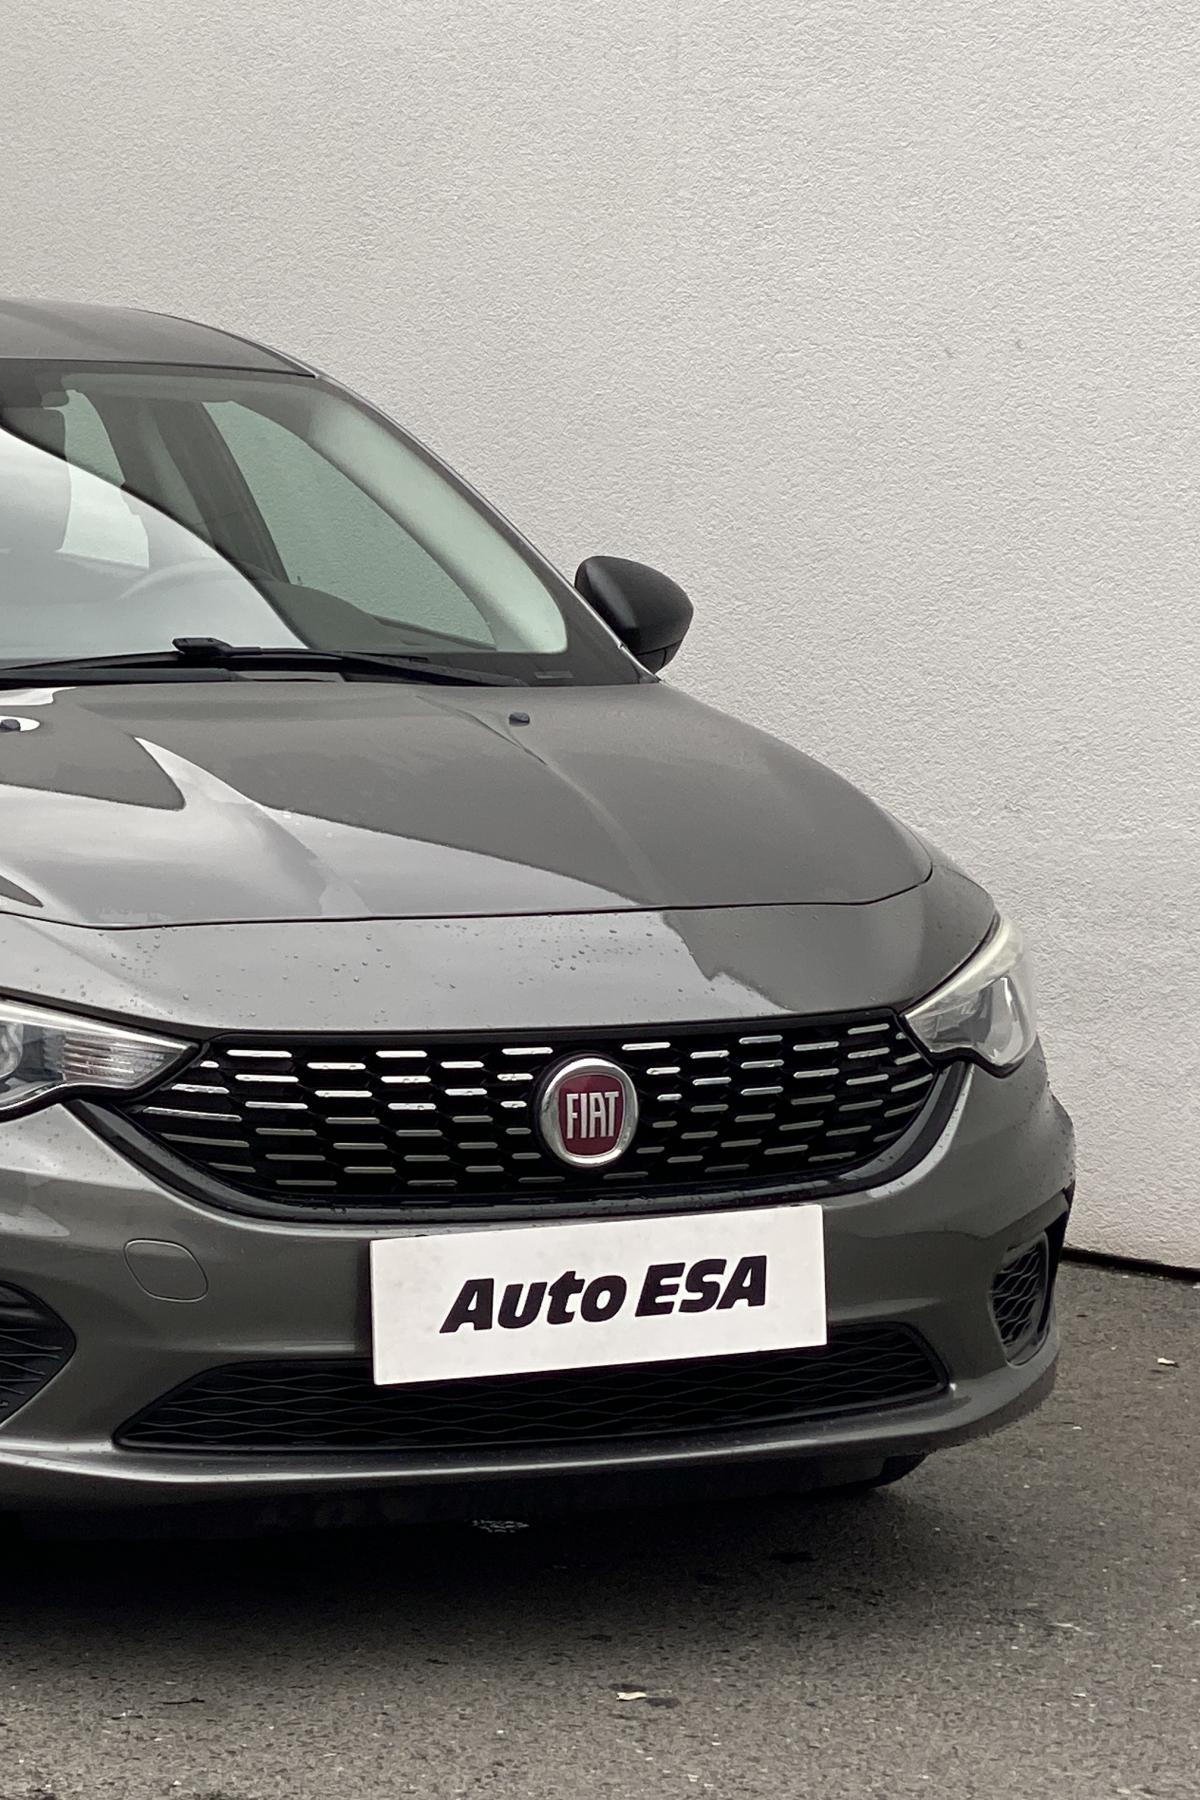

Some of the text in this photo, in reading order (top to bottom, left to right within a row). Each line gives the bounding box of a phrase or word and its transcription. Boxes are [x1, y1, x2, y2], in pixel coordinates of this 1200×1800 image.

[566, 1091, 619, 1139] FIAT
[439, 1254, 767, 1334] Auto ESA
